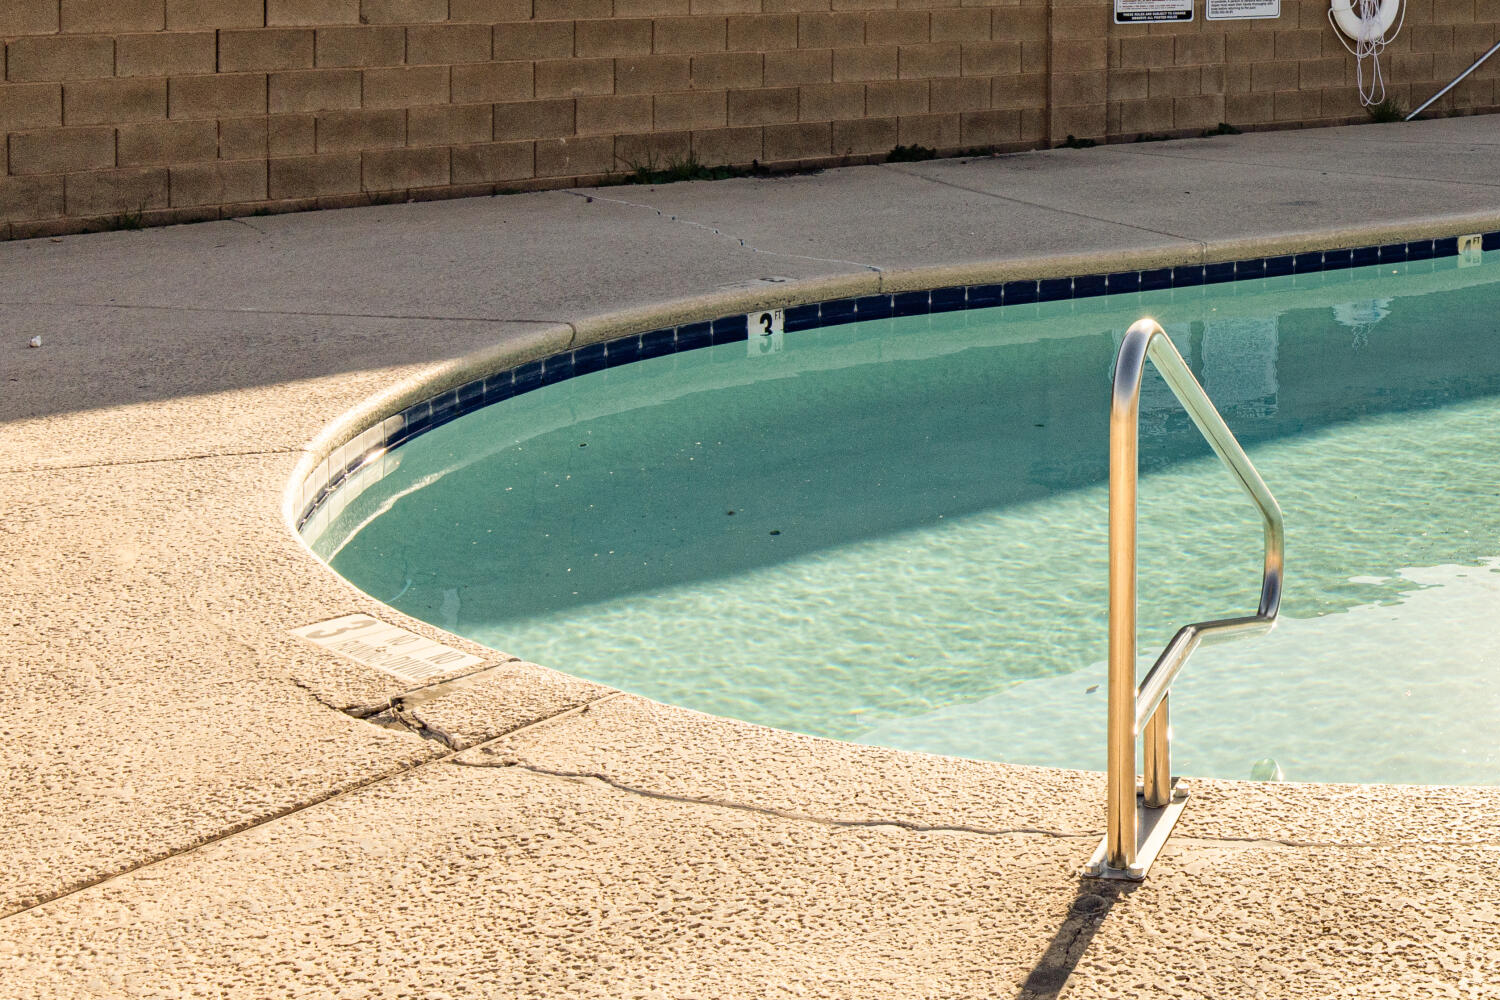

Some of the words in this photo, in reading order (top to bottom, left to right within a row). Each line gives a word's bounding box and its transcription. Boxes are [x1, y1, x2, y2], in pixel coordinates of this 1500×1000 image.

[1473, 236, 1481, 245] FT
[759, 312, 773, 336] 3
[775, 310, 782, 320] FT
